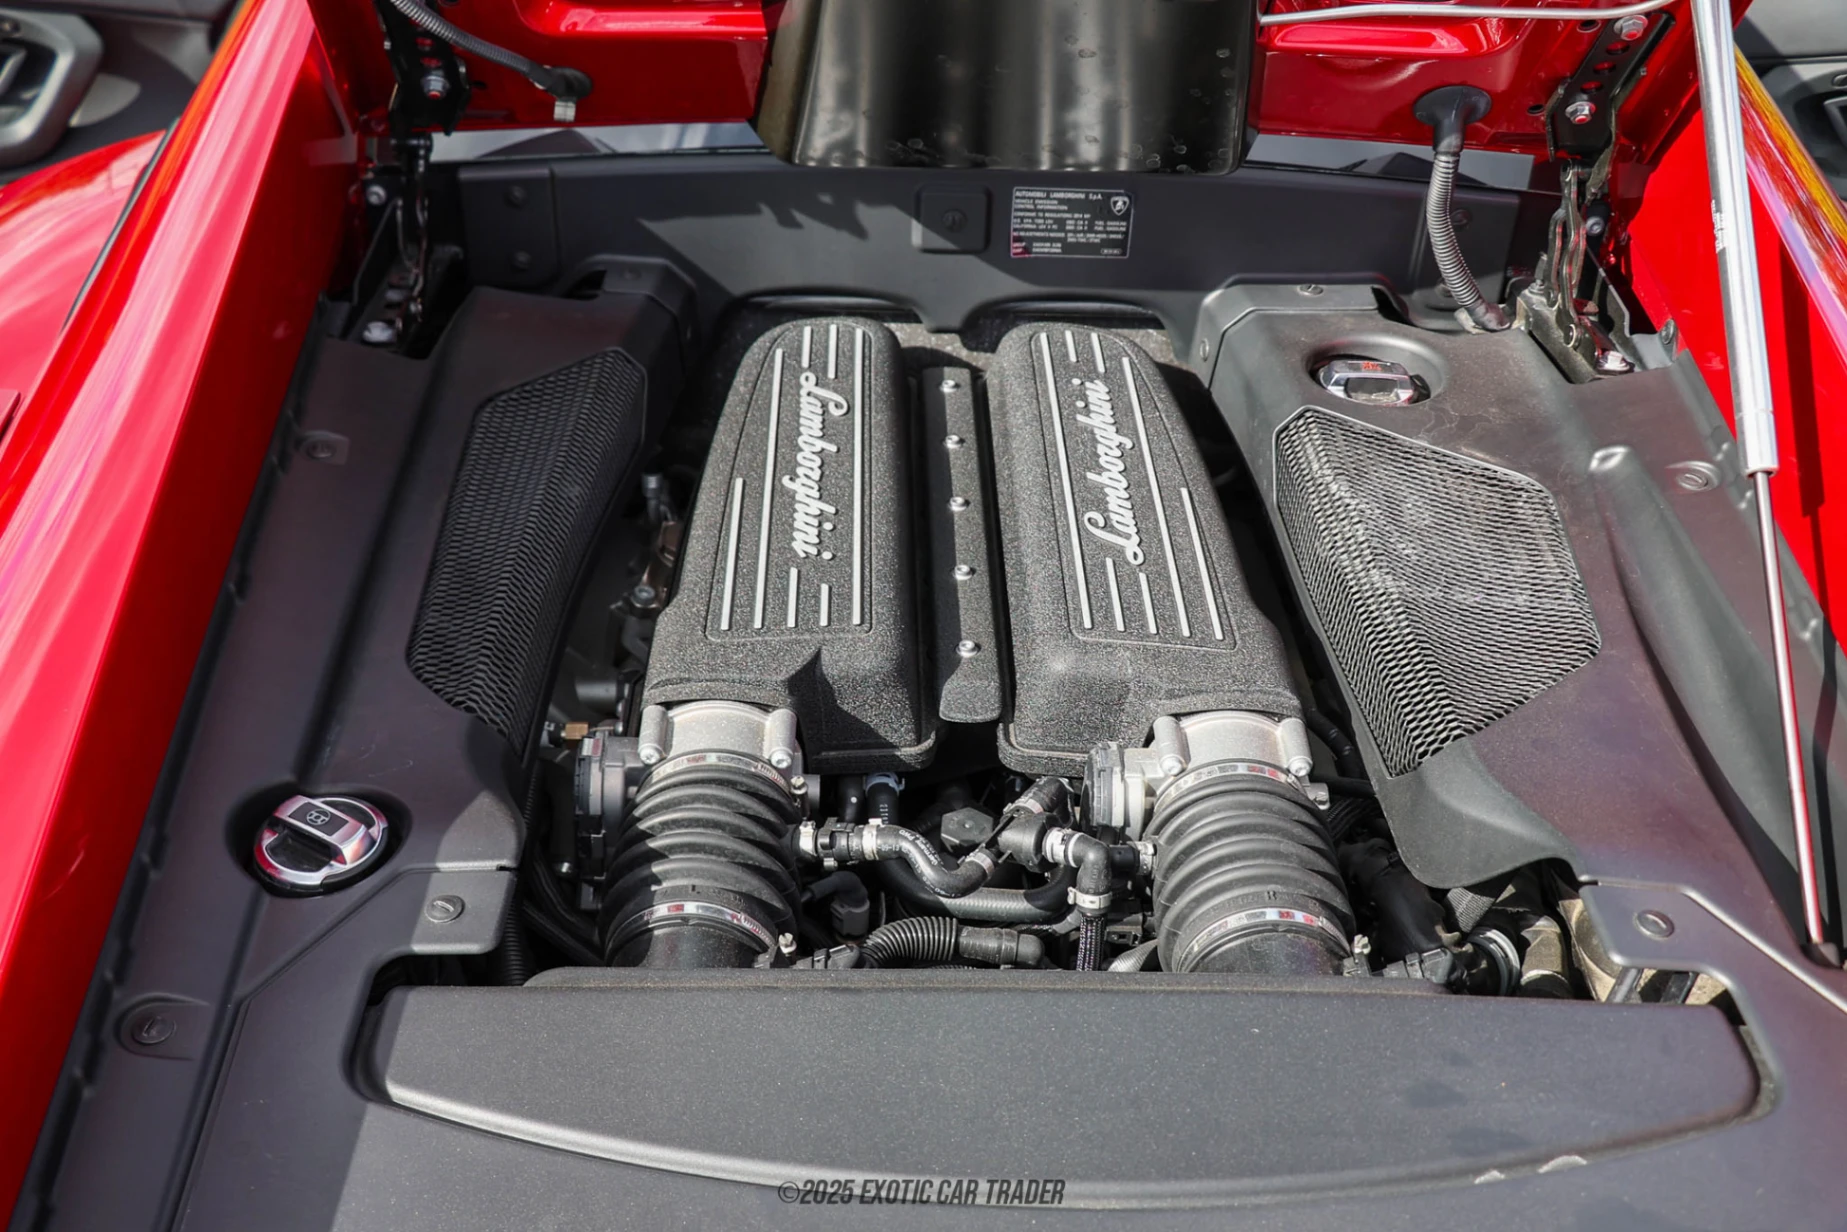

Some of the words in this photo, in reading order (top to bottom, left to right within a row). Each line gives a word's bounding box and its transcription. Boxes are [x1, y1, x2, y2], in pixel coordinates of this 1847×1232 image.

[782, 371, 850, 561] Lamborghini
[1071, 378, 1145, 566] Lamborghini
[915, 838, 939, 866] Germany
